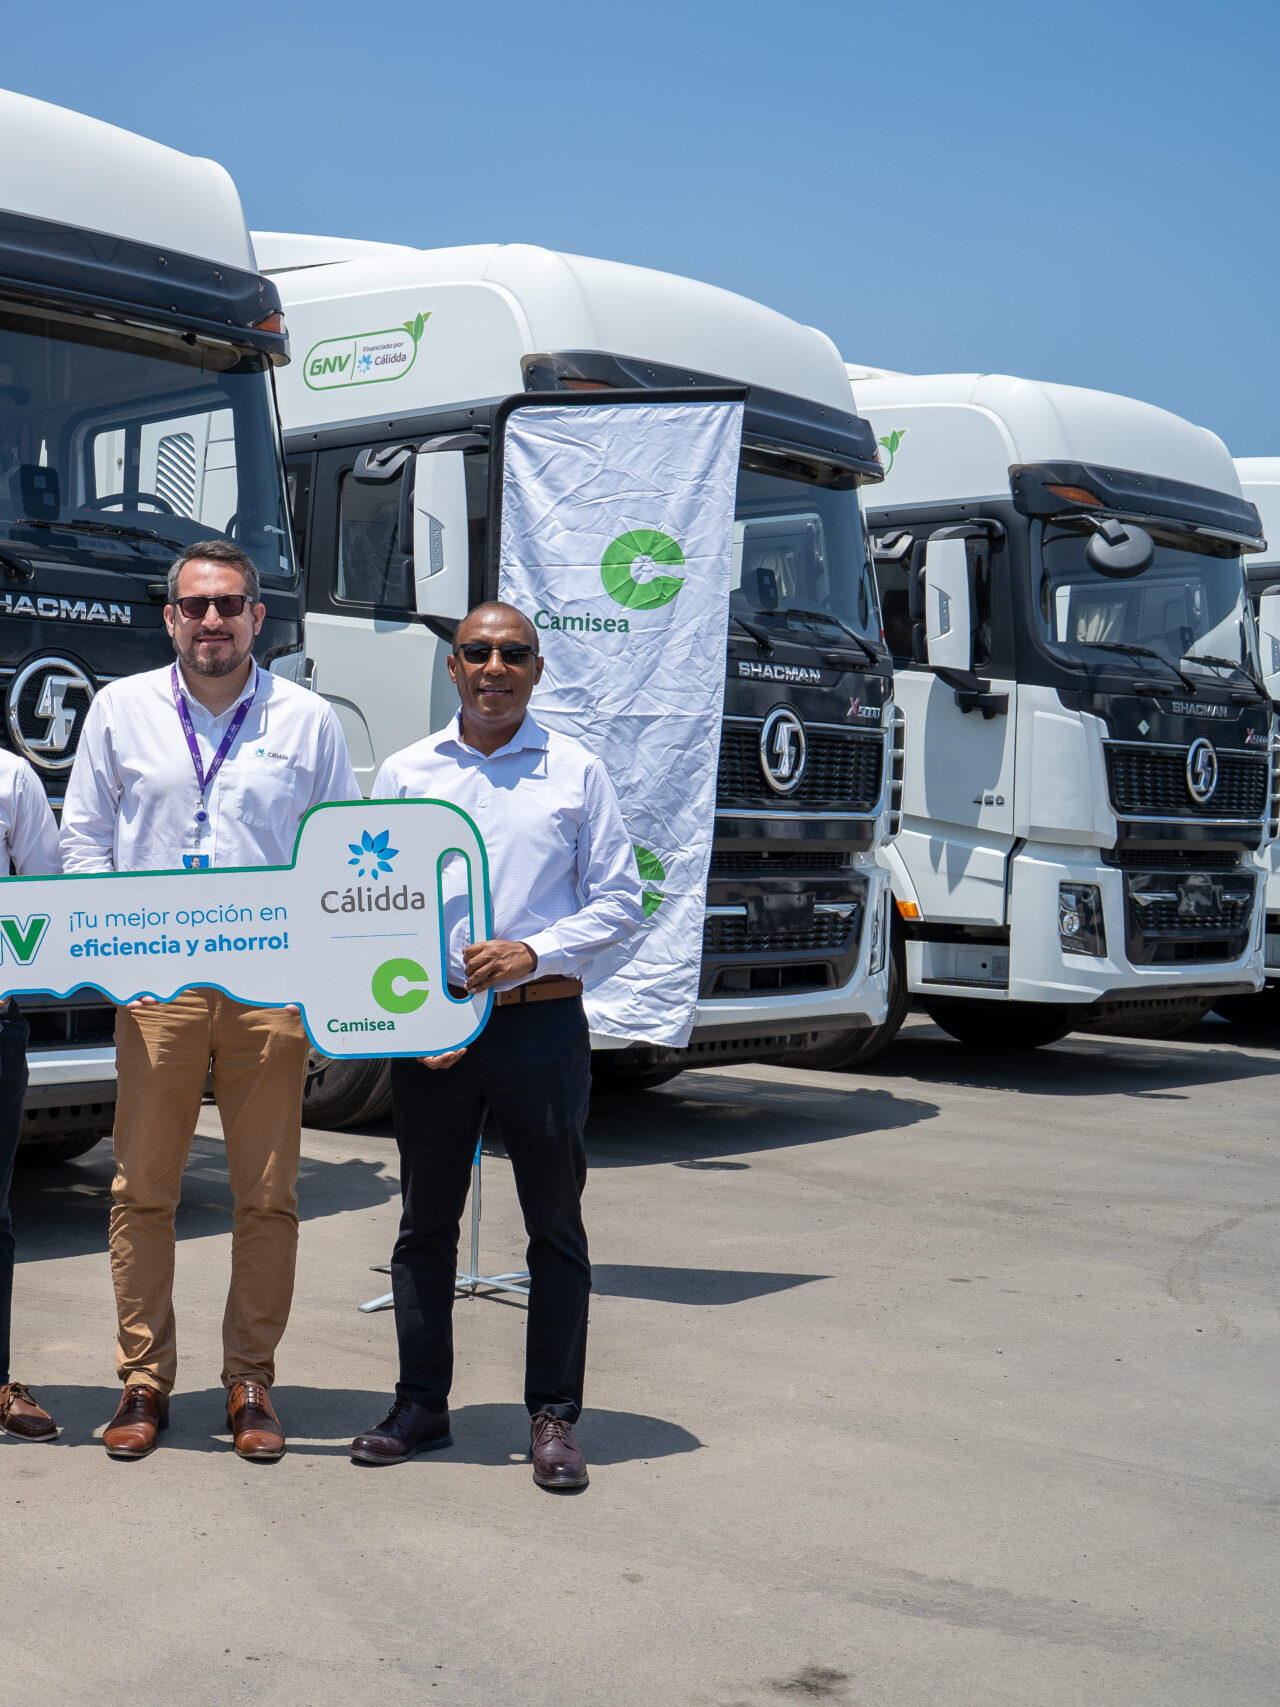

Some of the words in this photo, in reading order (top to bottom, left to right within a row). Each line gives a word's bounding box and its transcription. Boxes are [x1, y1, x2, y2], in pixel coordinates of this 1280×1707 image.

[362, 343, 393, 353] Financiado
[393, 341, 404, 349] por
[309, 354, 352, 376] GNV
[374, 352, 407, 366] Cálidda
[533, 609, 631, 633] Camisea
[738, 661, 821, 684] SHACMAN
[846, 696, 881, 719] X5000
[1172, 701, 1228, 718] SHACMAN
[320, 885, 426, 914] Cálidda
[69, 911, 98, 933] ¡Tu
[105, 909, 170, 930] mejor
[176, 903, 253, 927] opción
[259, 906, 288, 921] en
[69, 935, 182, 958] eficiencia
[186, 938, 200, 956] y
[205, 932, 290, 953] ahorro!
[327, 1018, 396, 1033] Camisea
